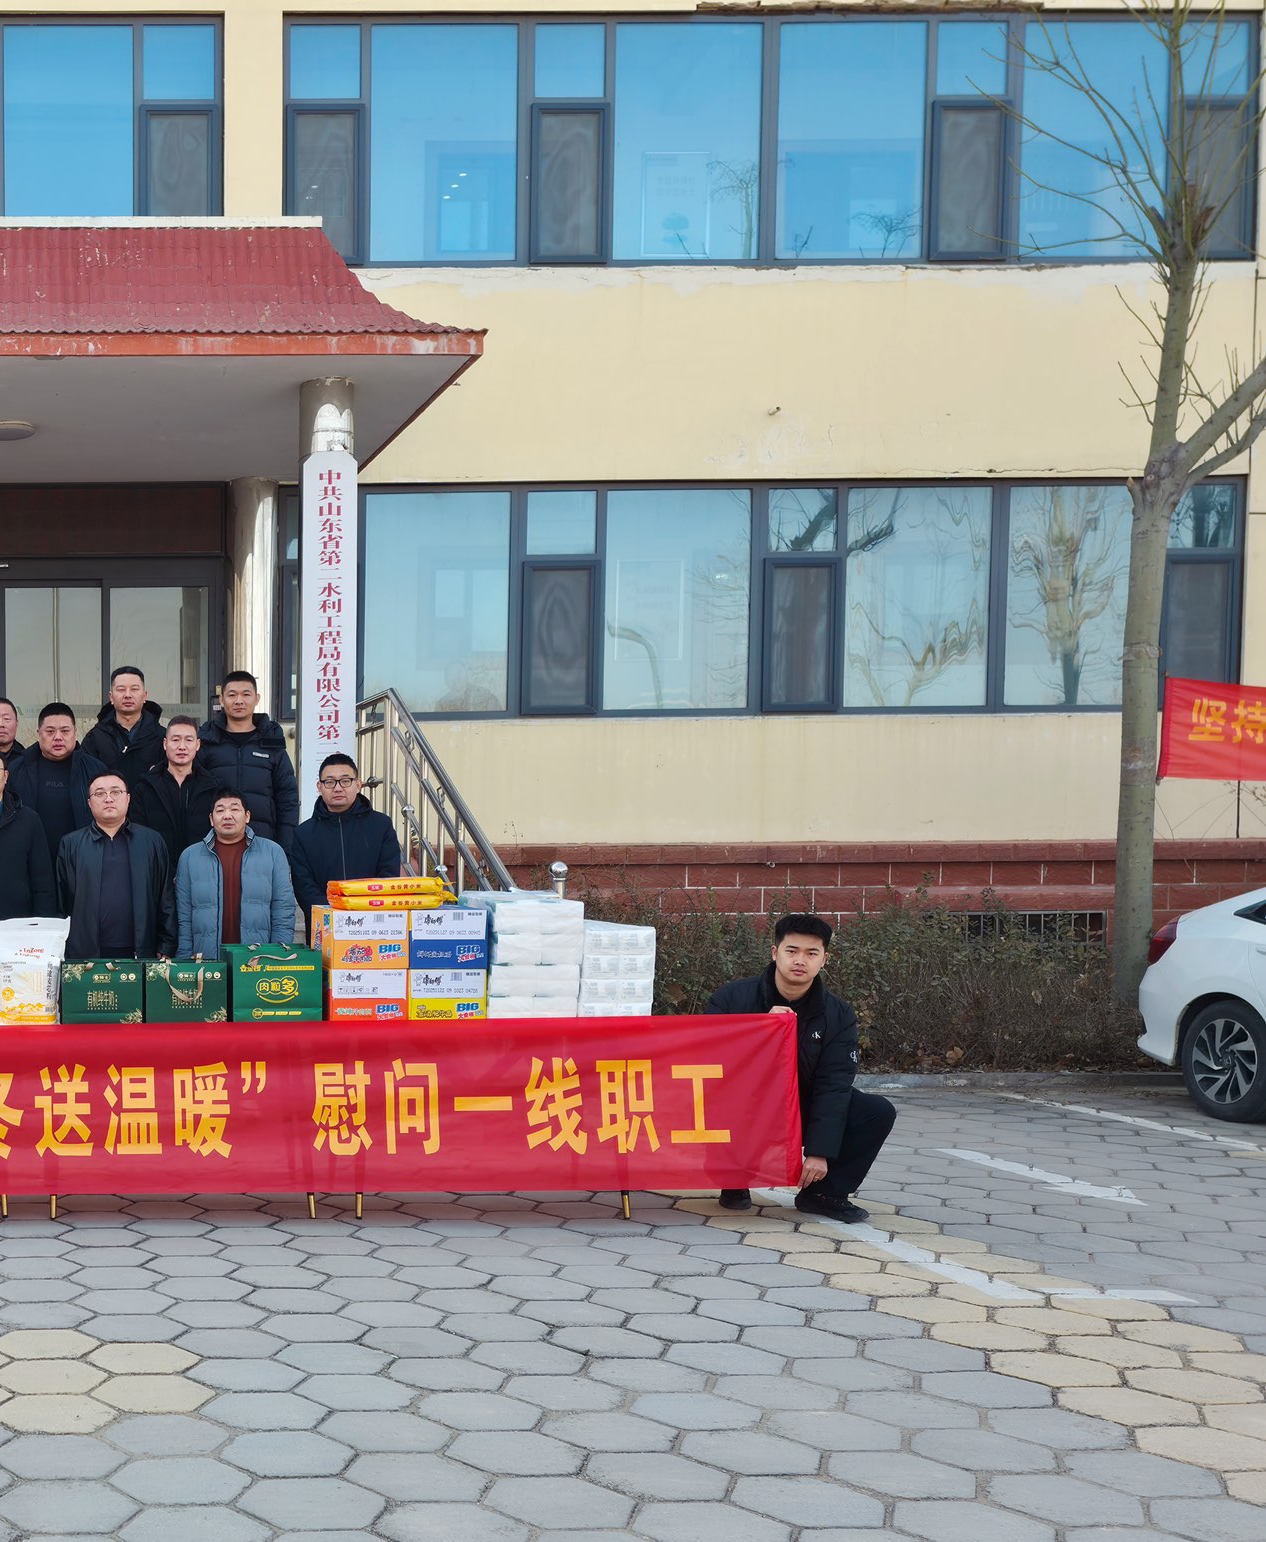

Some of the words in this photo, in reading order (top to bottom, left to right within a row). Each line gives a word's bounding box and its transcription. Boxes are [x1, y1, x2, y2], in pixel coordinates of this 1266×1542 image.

[316, 469, 343, 757] 中共山东省第二水利工程局有限公司第二
[1189, 698, 1266, 745] 坚持
[379, 944, 402, 954] BIG
[456, 945, 481, 955] BIG
[259, 979, 295, 995] 肉粒多
[376, 1004, 399, 1014] BIG
[456, 1003, 480, 1012] BIG
[312, 1057, 731, 1157] 慰问一线职工
